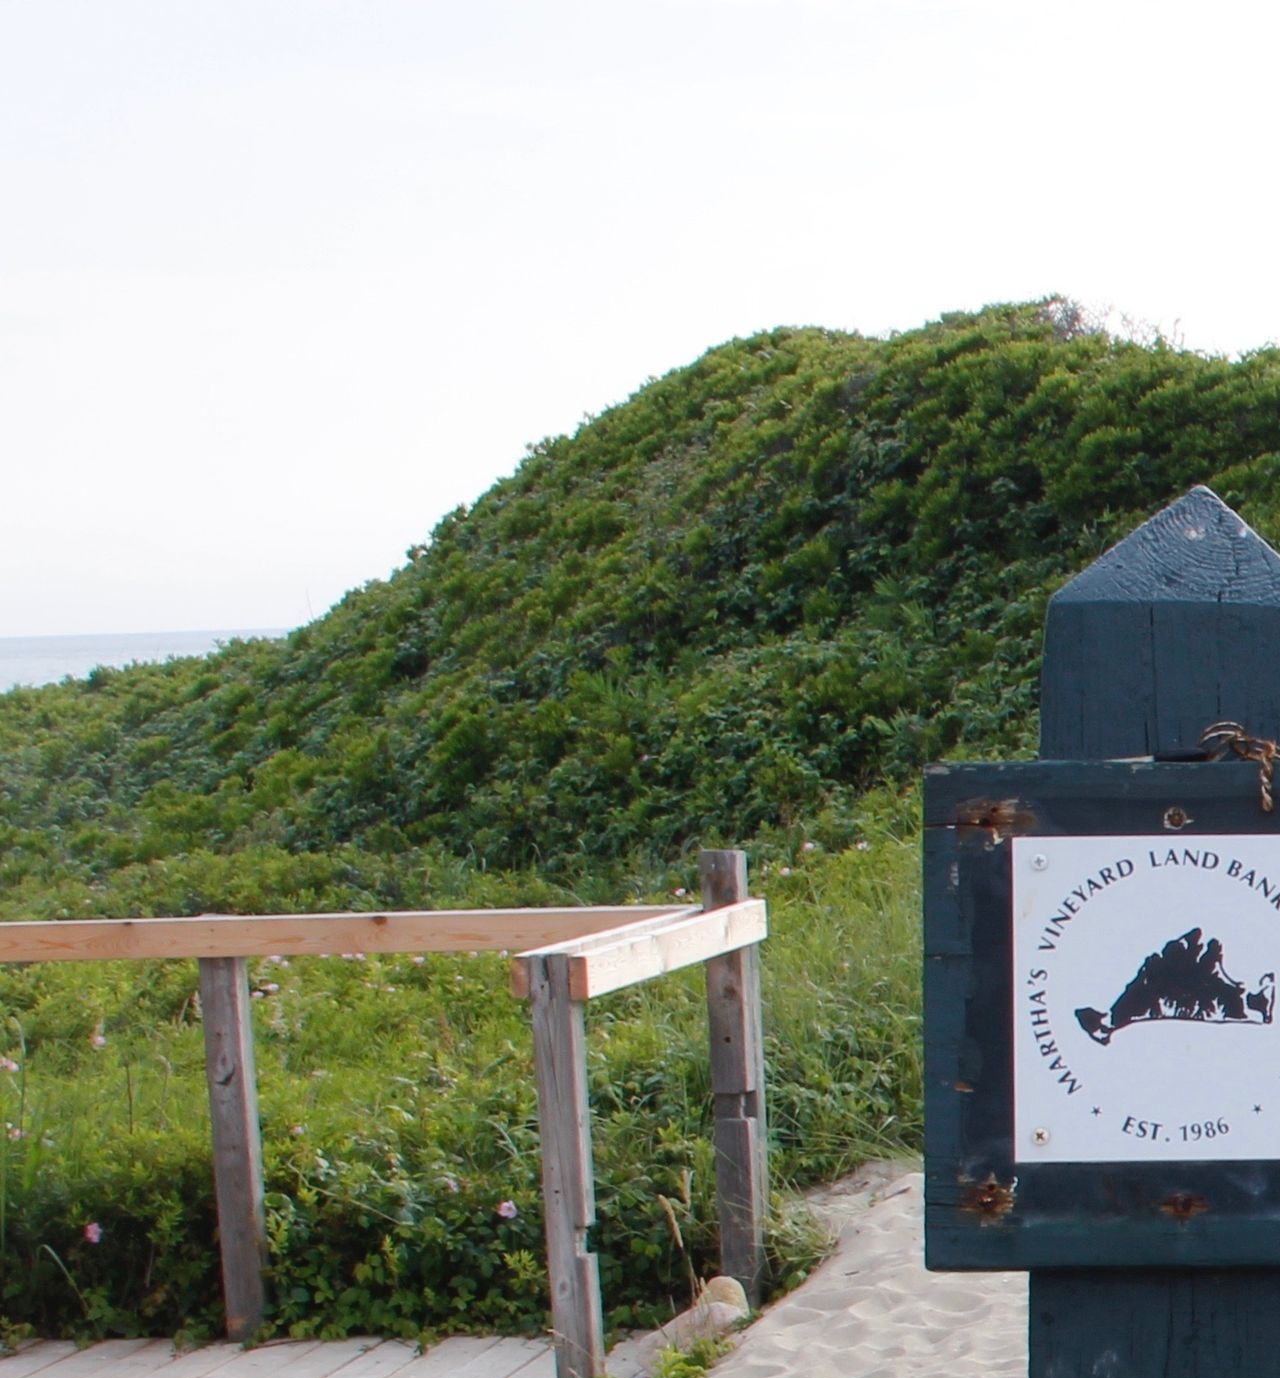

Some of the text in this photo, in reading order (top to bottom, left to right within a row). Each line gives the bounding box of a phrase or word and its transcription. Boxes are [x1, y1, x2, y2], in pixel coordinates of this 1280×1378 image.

[1149, 849, 1220, 871] LAND
[1038, 858, 1135, 952] VINEYARD
[1027, 968, 1083, 1095] MARTHA'S
[1121, 1115, 1230, 1143] EST. 1986
